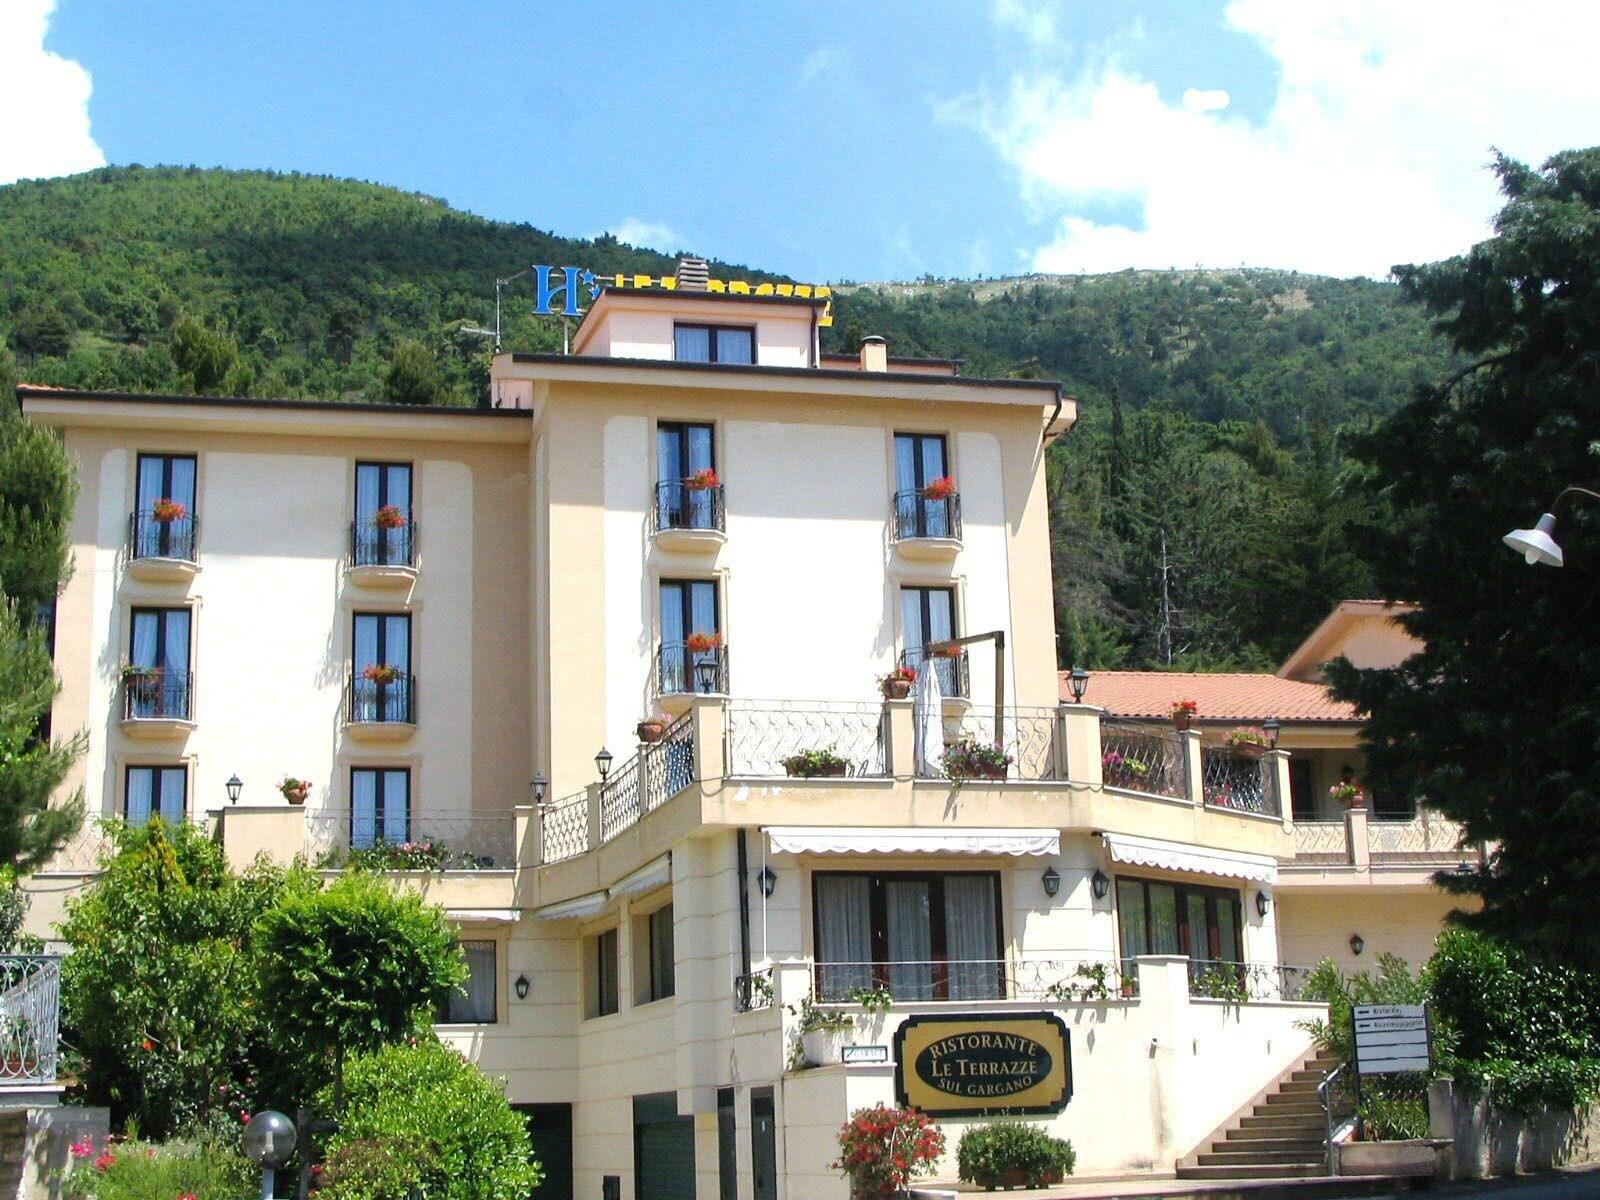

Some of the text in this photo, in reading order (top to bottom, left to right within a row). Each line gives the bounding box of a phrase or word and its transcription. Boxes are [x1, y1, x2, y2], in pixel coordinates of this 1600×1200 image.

[928, 1033, 1039, 1059] RISTORANTE
[938, 1076, 1032, 1096] SUL GARGANO
